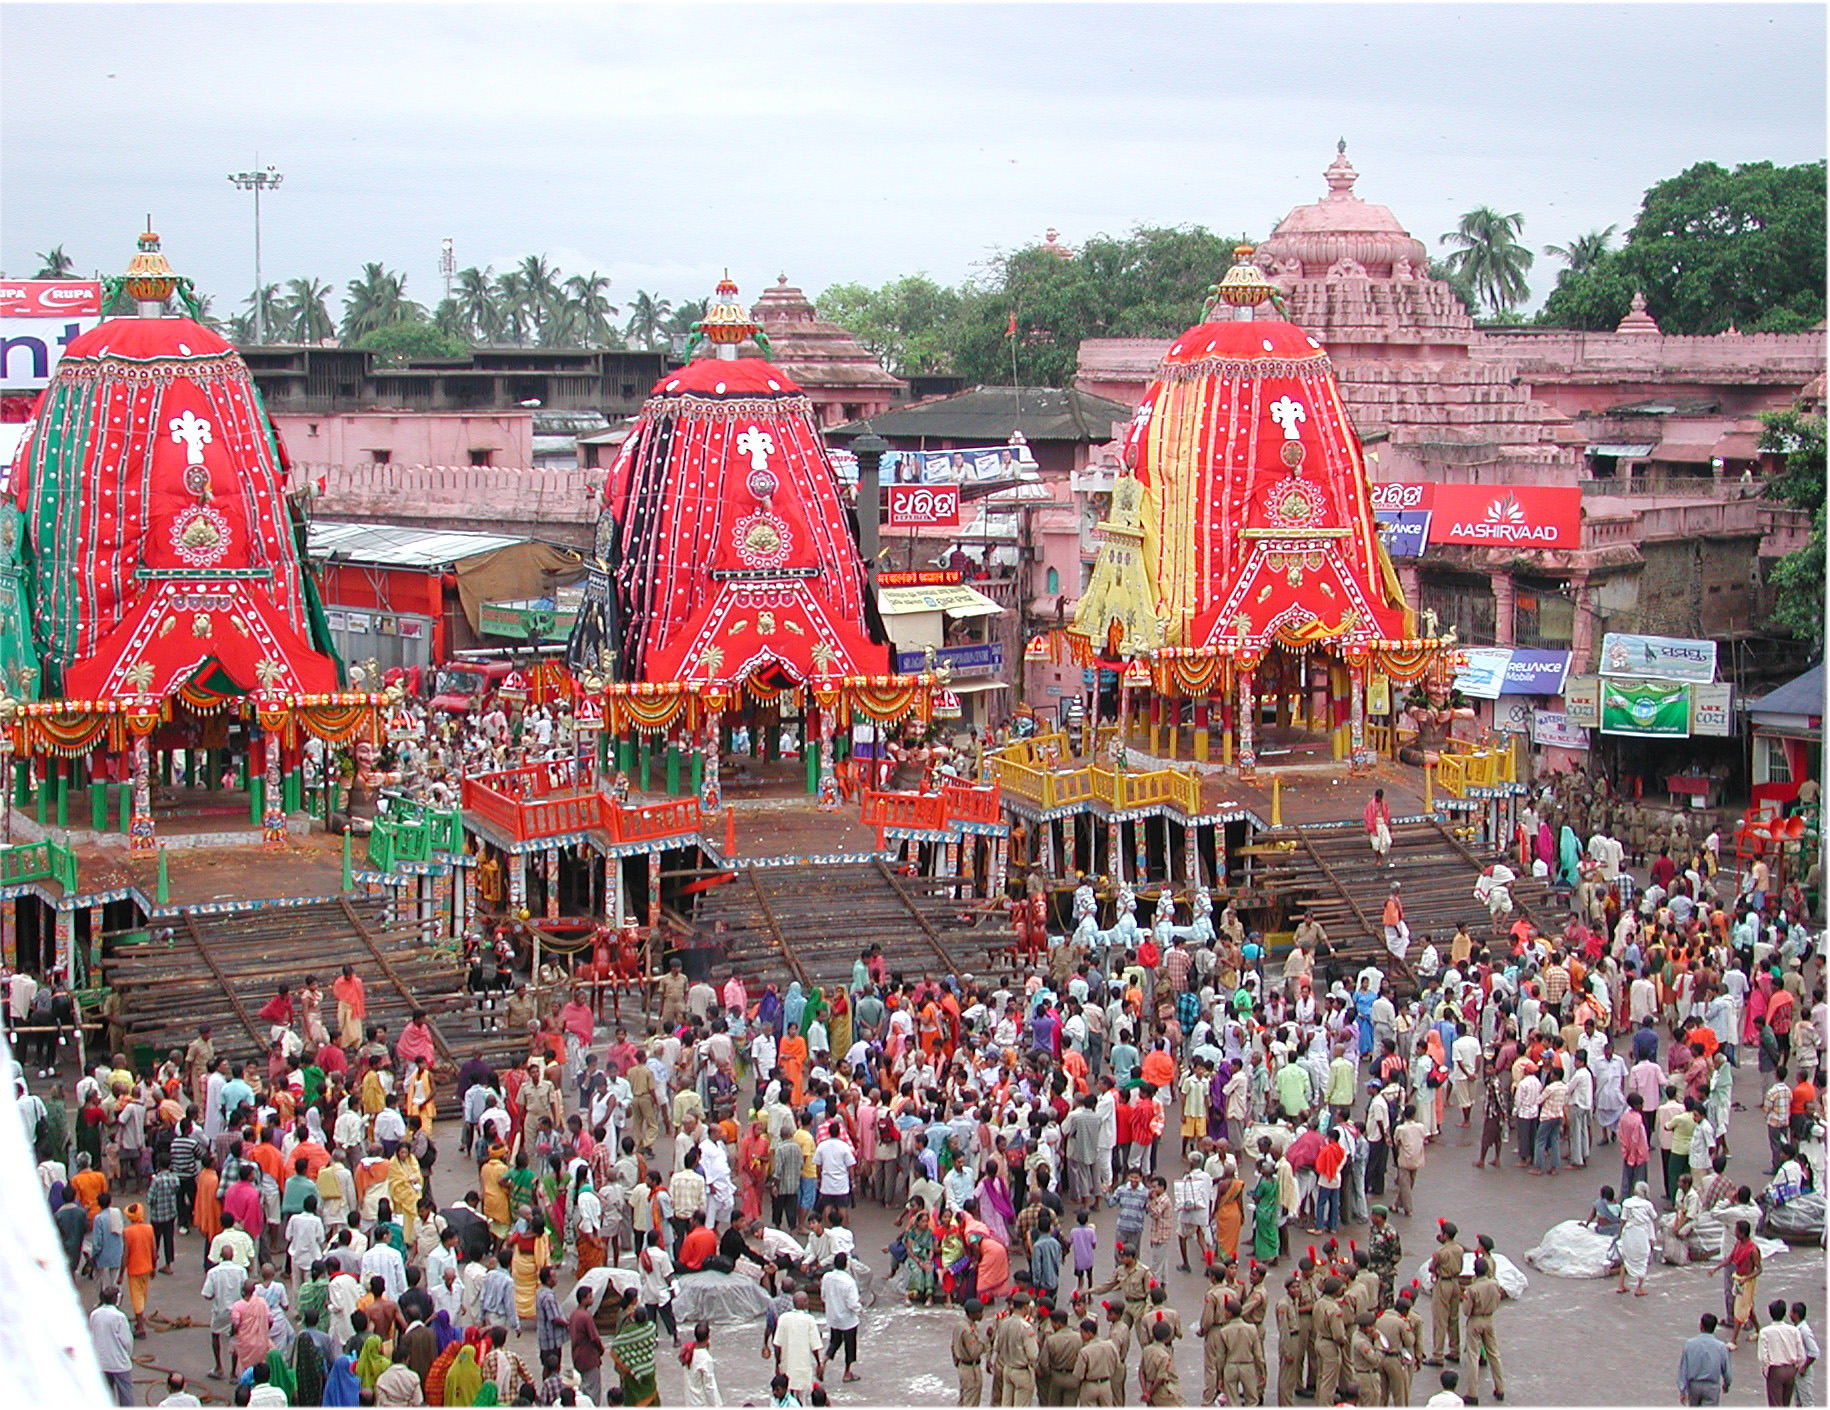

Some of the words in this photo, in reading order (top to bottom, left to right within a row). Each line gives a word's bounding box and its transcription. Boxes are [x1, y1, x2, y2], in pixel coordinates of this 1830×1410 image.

[0, 289, 27, 299] UPA
[53, 289, 94, 299] RUPA
[894, 489, 956, 521] ଧରିତ୍ରୀ
[1450, 523, 1558, 542] AASHIRVAAD
[1507, 662, 1562, 673] RELIANCE
[1506, 673, 1536, 682] Mobile
[1566, 705, 1595, 717] COZI
[1701, 704, 1721, 712] LUX
[1695, 712, 1725, 724] COZI
